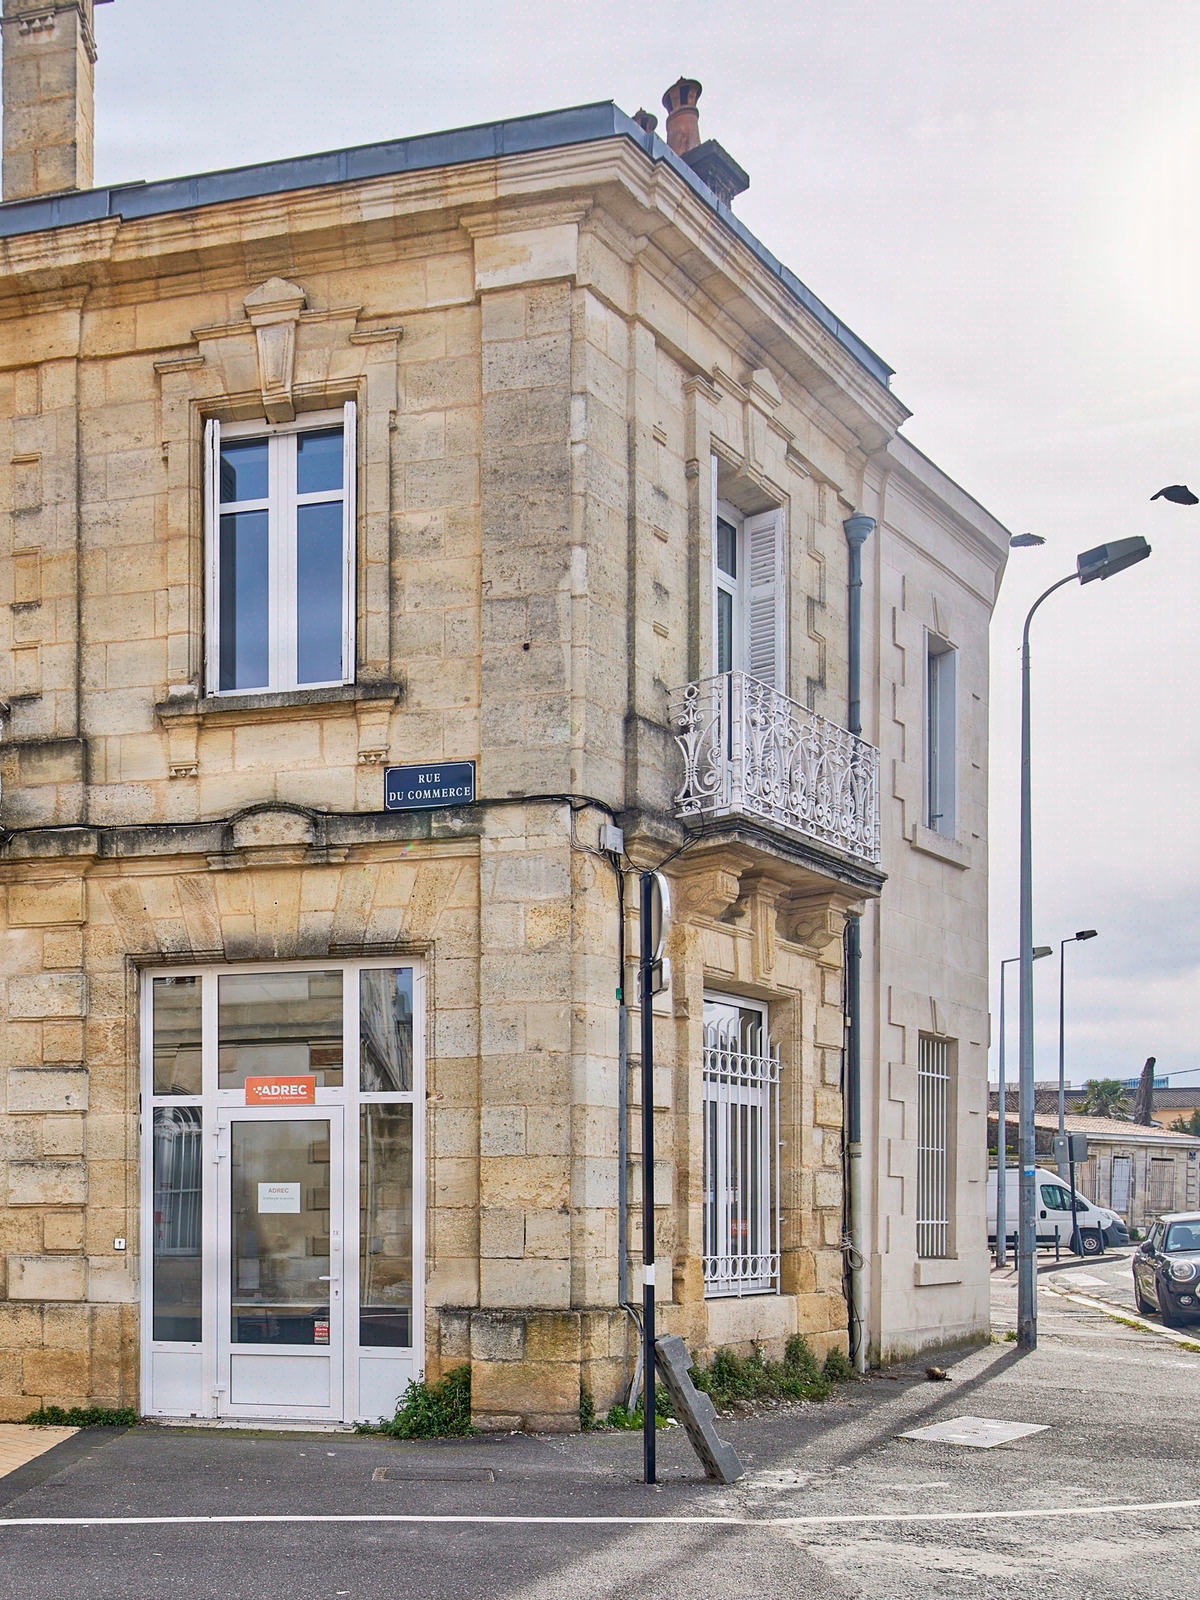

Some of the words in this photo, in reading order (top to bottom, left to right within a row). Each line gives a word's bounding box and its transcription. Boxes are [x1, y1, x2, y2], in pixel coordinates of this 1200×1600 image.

[418, 773, 441, 784] RUE
[389, 791, 404, 802] DU
[407, 786, 471, 800] COMMERCE
[261, 1084, 307, 1095] ADREC
